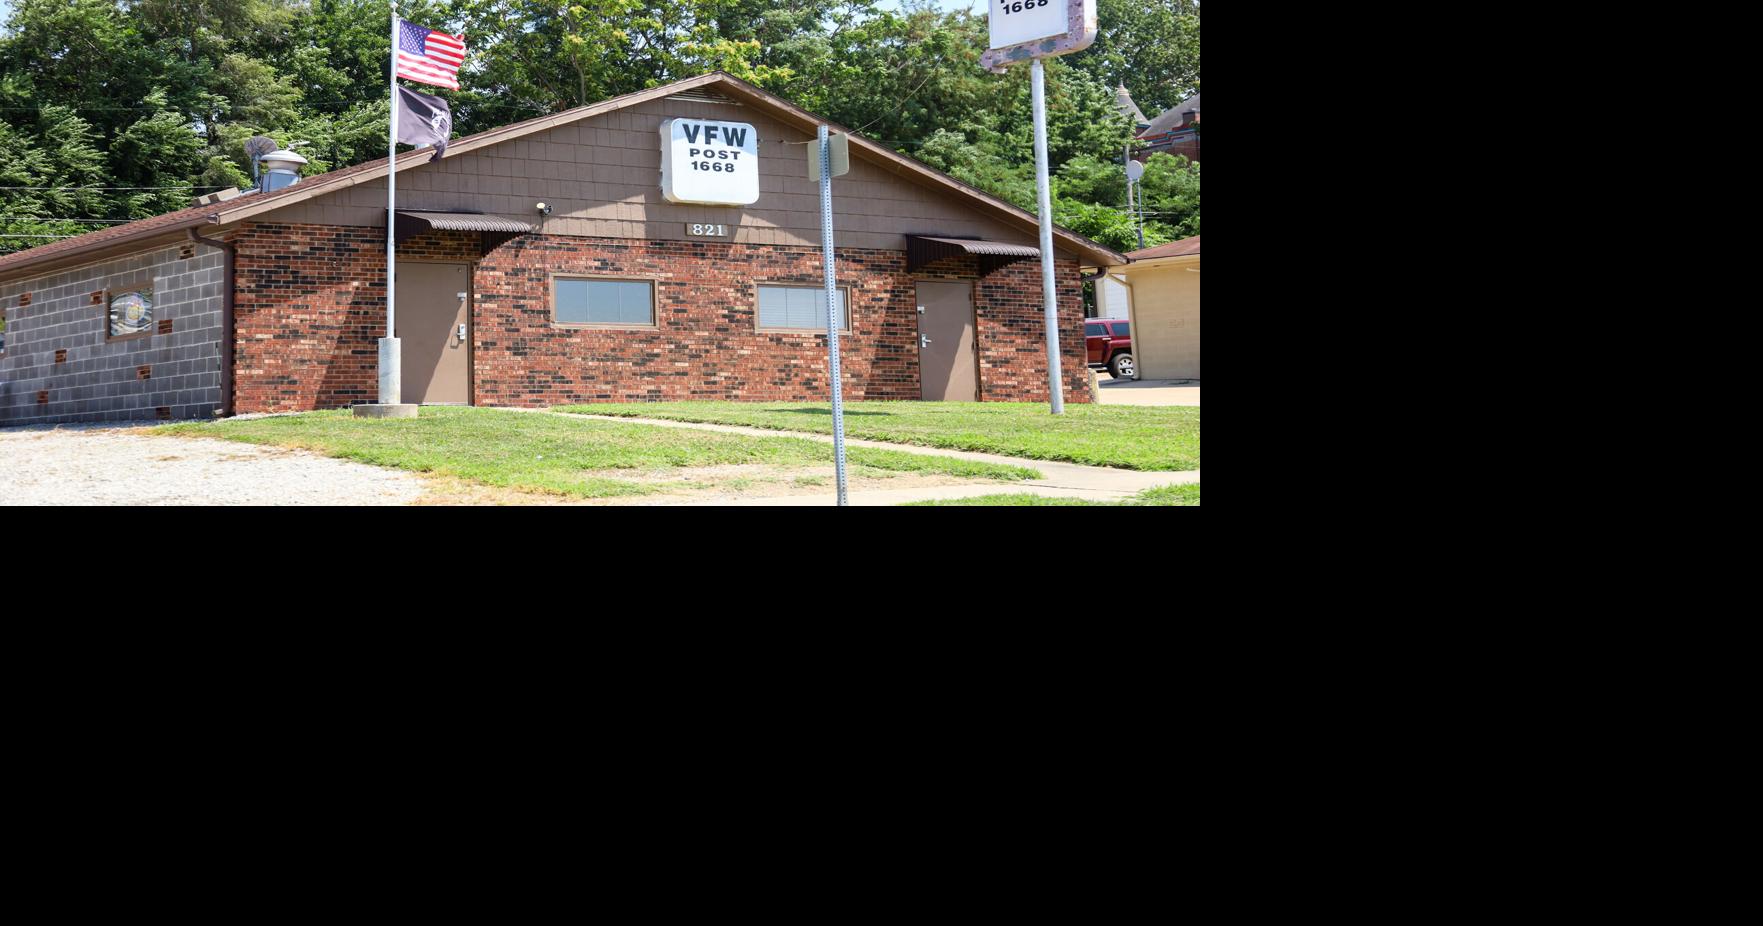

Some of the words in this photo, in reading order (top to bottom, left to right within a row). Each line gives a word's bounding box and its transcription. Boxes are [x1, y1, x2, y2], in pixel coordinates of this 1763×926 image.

[682, 124, 747, 147] VFW
[689, 148, 741, 160] POST
[691, 161, 735, 173] 1668
[693, 224, 724, 236] 821
